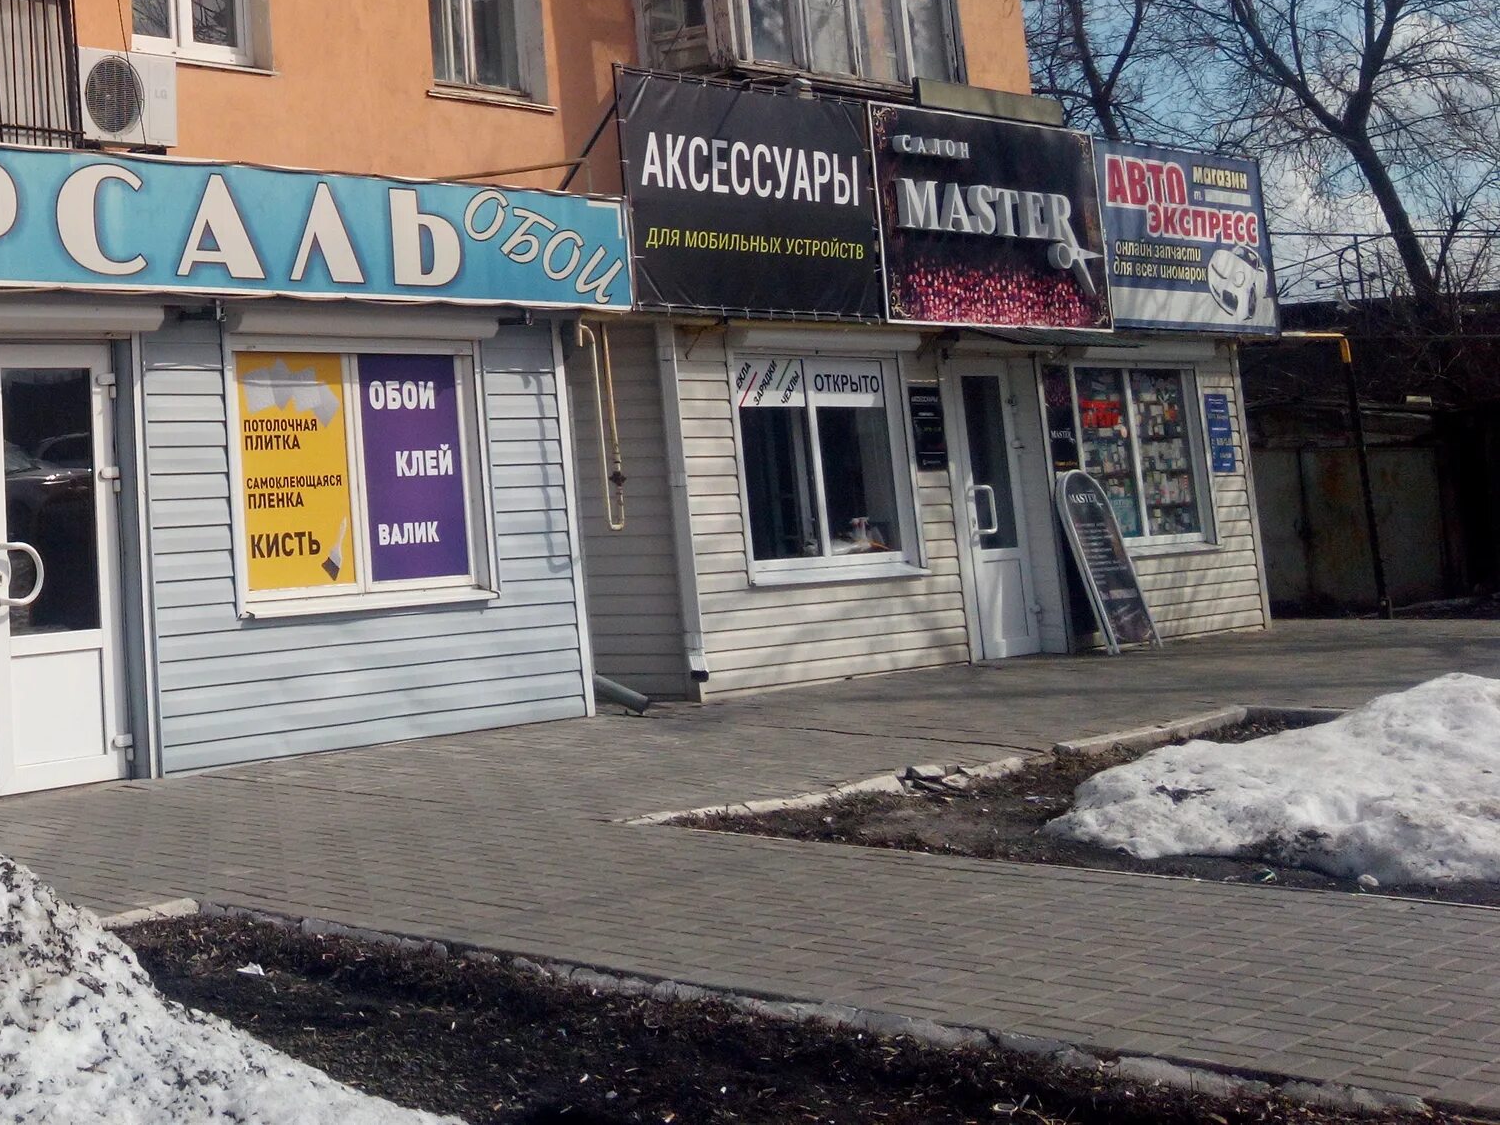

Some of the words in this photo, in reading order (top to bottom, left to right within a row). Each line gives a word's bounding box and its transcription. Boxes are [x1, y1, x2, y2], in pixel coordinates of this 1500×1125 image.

[900, 134, 970, 159] САЛОН
[641, 131, 859, 206] АКСЕССУАРЫ
[1105, 155, 1189, 208] АВТО
[1192, 165, 1248, 190] магазин
[894, 178, 1080, 249] MASTER
[1146, 203, 1260, 248] ЭКСПРЕСС
[462, 187, 625, 305] ОБОИ
[645, 227, 680, 249] ДЛЯ
[685, 230, 782, 254] МОБИЛЬНЫХ
[785, 237, 865, 260] УСТРОЙСТВ
[1115, 238, 1152, 257] онлайн
[1154, 245, 1202, 262] запчасти
[1113, 256, 1133, 276] для
[1135, 261, 1159, 278] всех
[1160, 264, 1208, 285] иномарок
[369, 380, 436, 410] ОБОИ
[753, 359, 779, 406] ЗАРЯДКИ
[781, 370, 801, 405] ЧЕХЛЫ
[814, 373, 880, 394] ОТКРЫТО
[243, 418, 318, 433] ПОТОЛОЧНАЯ
[244, 434, 301, 451] ПЛИТКА
[395, 444, 454, 477] КЛЕЙ
[246, 474, 342, 490] САМОКЛЕЮЩАЯСЯ
[247, 492, 304, 509] ПЛЕНКА
[250, 531, 321, 559] КИСТЬ
[378, 521, 440, 546] ВАЛИК
